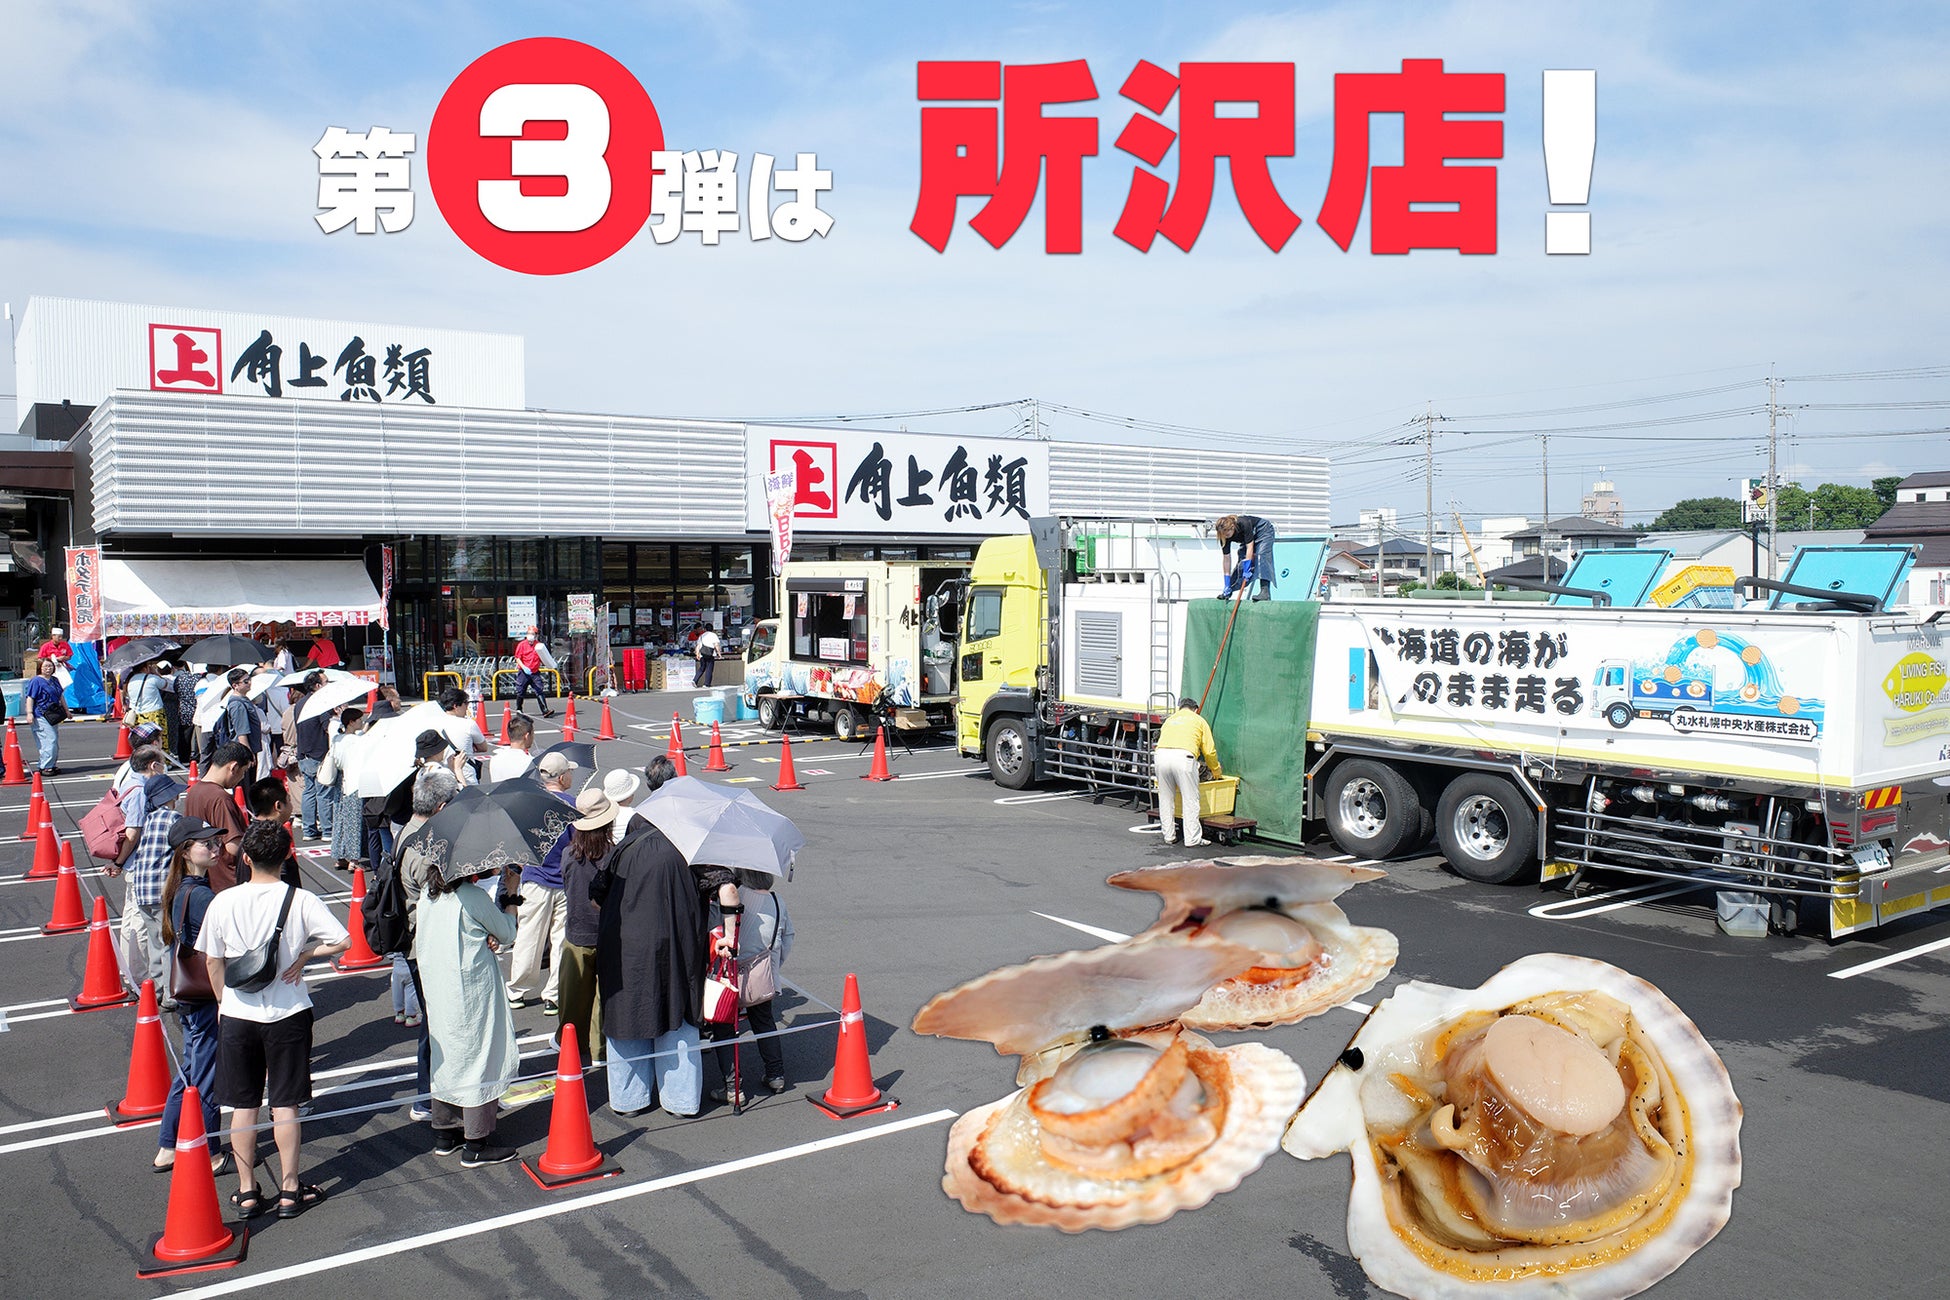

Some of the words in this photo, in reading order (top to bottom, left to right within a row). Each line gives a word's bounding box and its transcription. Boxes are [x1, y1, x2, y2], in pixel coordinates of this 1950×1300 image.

[231, 328, 437, 405] 角上魚類
[845, 441, 1032, 522] 角上魚類
[297, 611, 369, 626] お会計
[1901, 663, 1927, 679] LIVING
[1929, 660, 1948, 677] FISH
[1893, 690, 1924, 709] HARUKI
[1676, 714, 1811, 736] 丸水札幌中央水産株式会社
